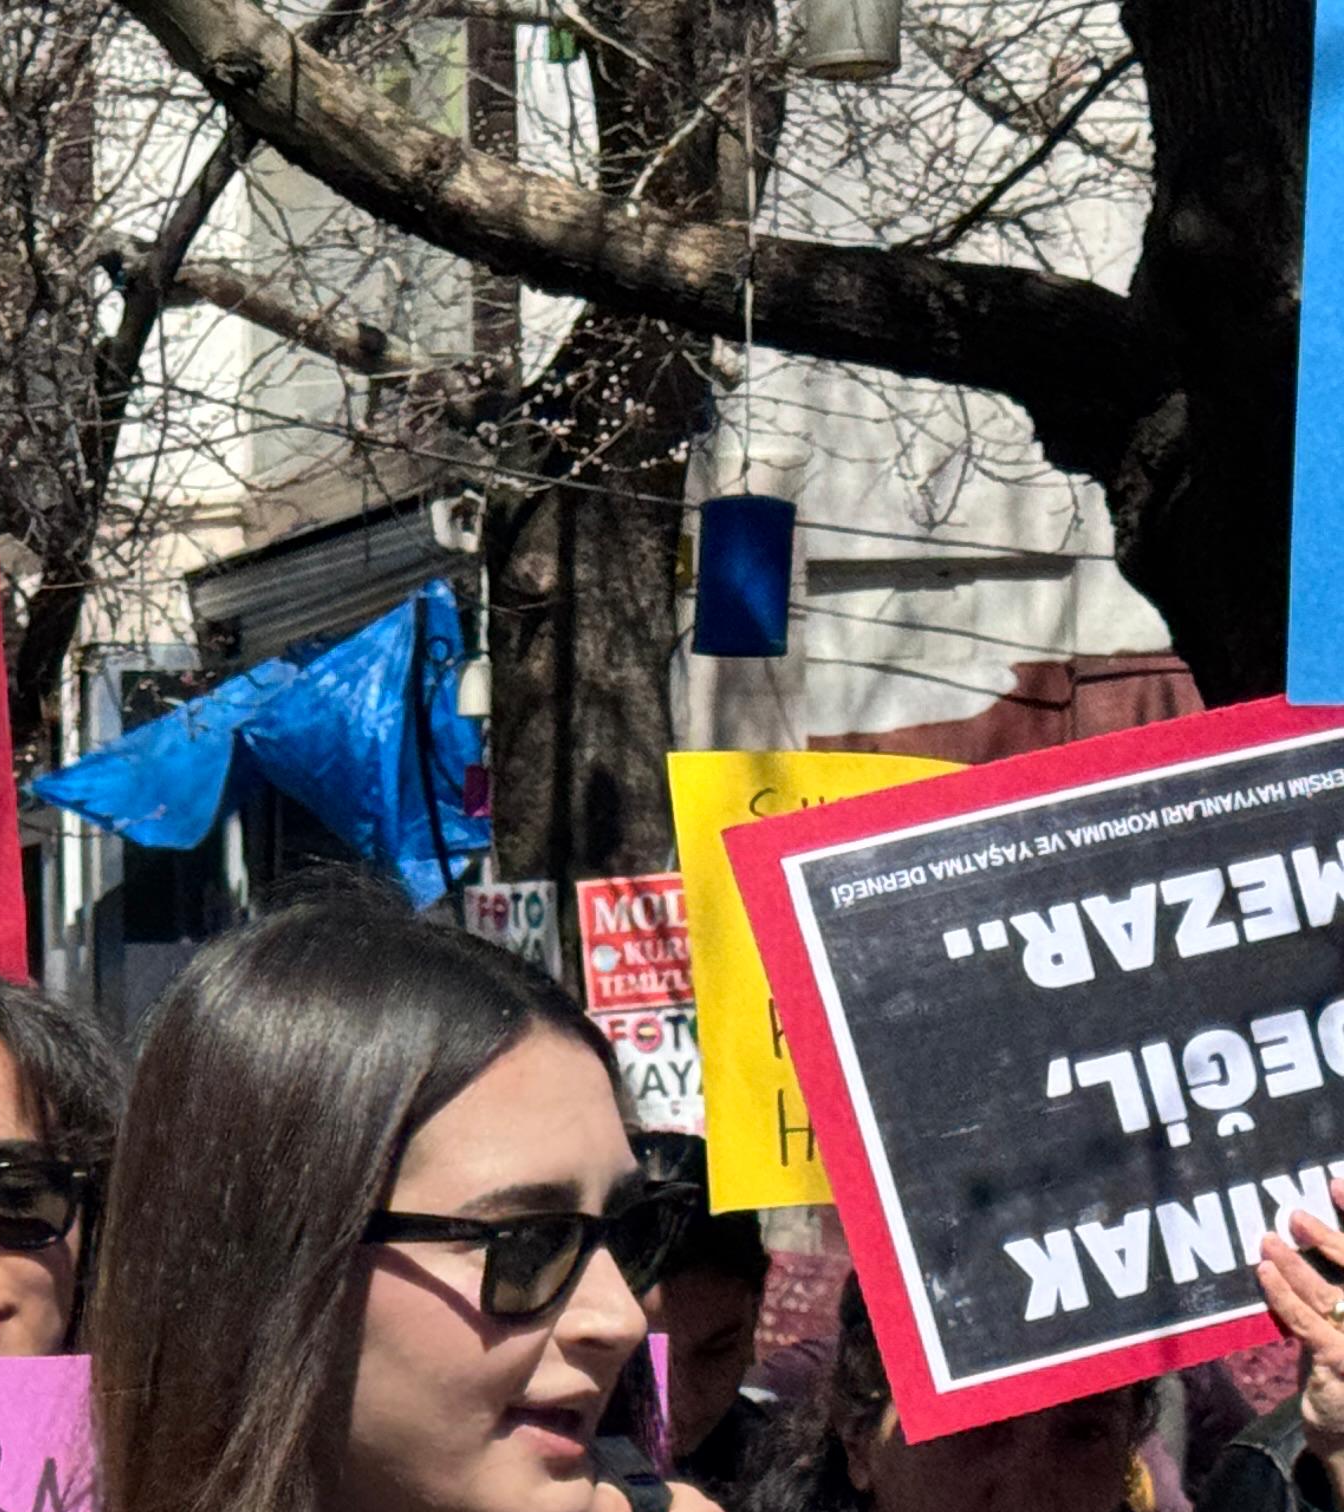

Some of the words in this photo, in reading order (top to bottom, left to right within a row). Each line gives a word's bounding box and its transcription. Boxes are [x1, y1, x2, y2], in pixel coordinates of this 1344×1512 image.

[1288, 769, 1344, 799] ERSİM
[1161, 780, 1287, 827] HAYVANLARI
[1034, 832, 1066, 857] VE
[1070, 810, 1159, 846] KORUMA
[929, 842, 1032, 880] YAŞATMA
[830, 870, 927, 909] DERNEĞİ
[623, 936, 691, 965] KUR
[608, 1014, 699, 1054] FOT
[1002, 1160, 1344, 1322] RINAK
